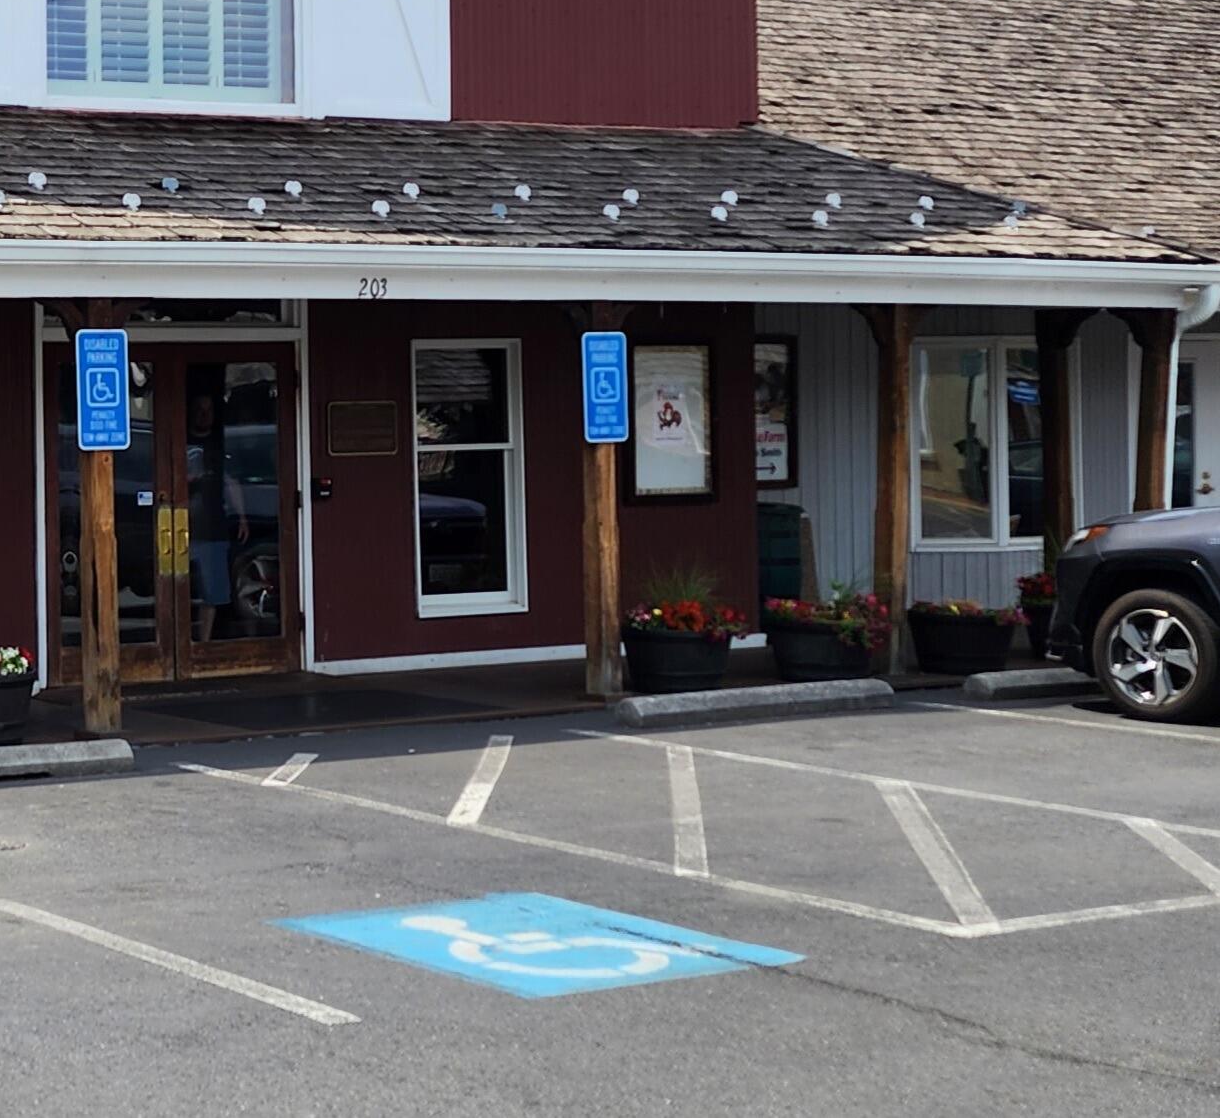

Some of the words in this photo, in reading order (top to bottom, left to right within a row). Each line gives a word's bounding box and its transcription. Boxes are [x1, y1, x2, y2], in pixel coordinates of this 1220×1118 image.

[358, 278, 388, 299] 203
[84, 338, 119, 350] DISABLED
[87, 352, 117, 364] PARKING
